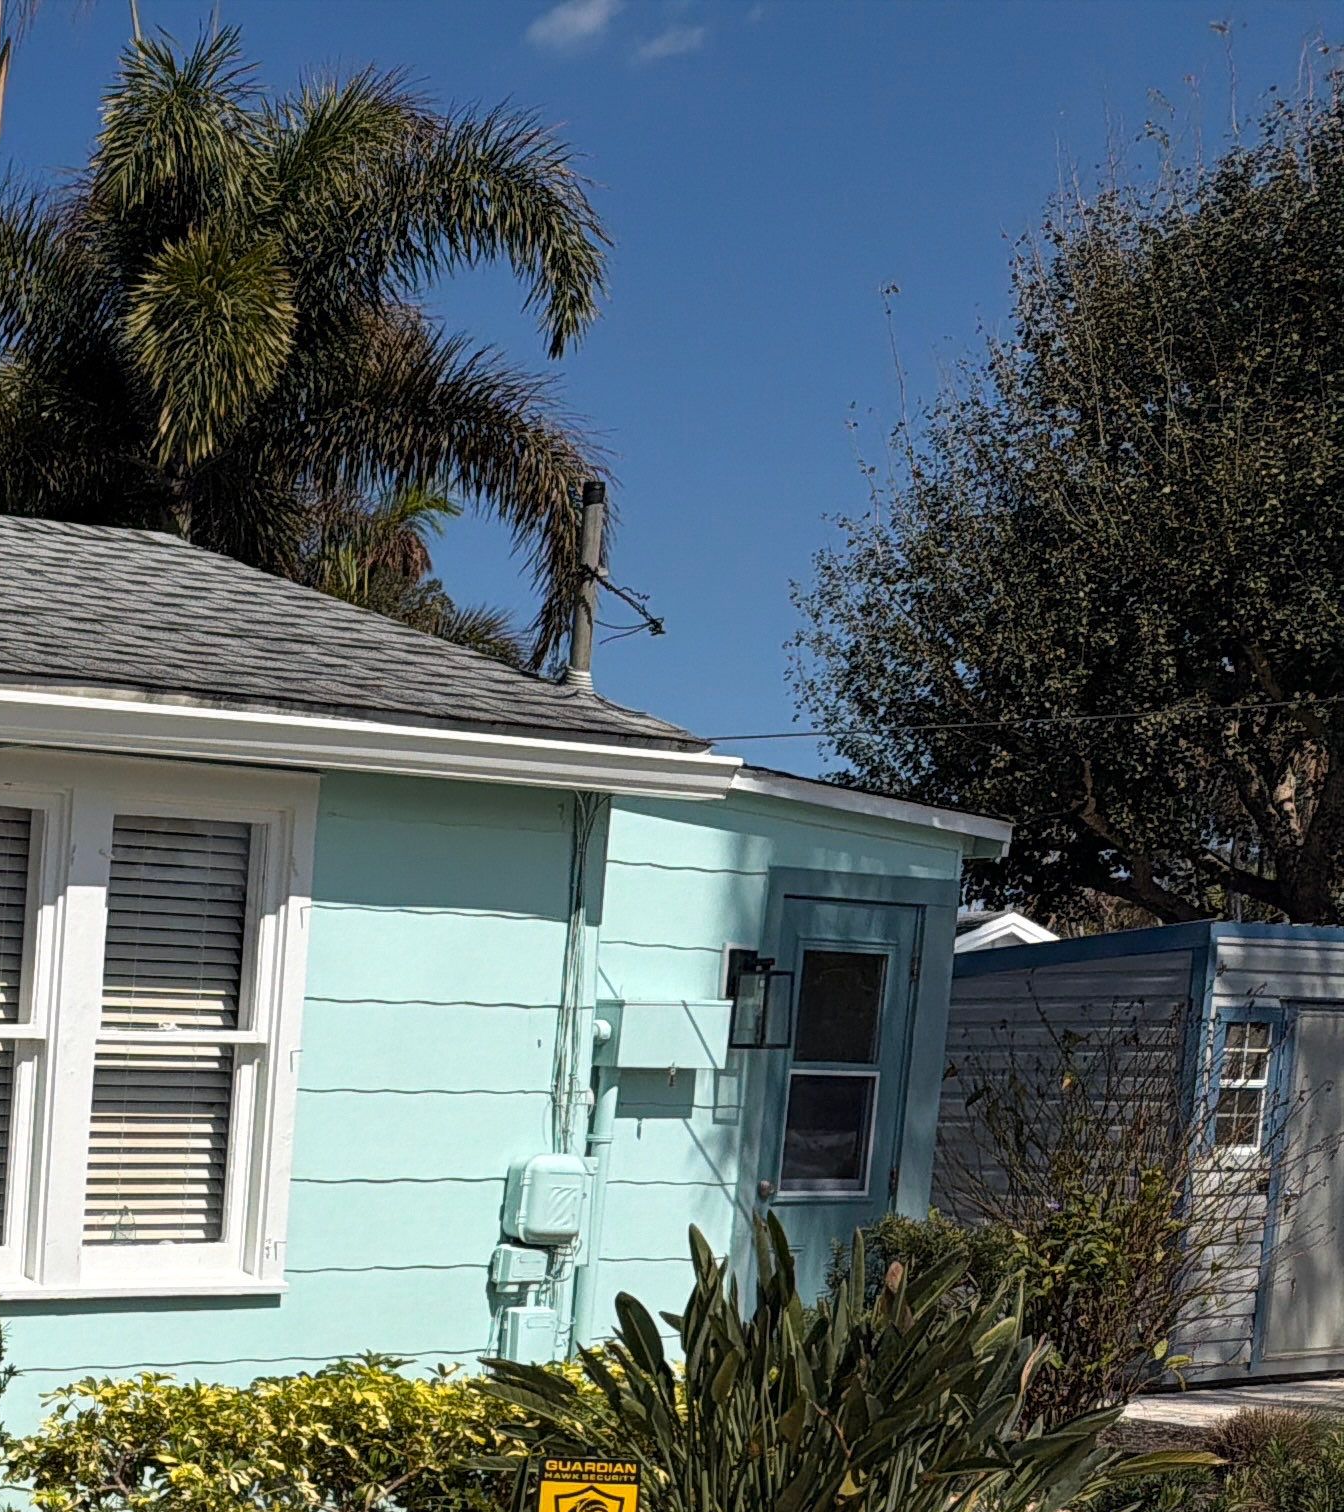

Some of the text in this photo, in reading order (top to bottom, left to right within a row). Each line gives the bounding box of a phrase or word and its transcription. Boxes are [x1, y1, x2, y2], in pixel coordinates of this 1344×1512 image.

[544, 1459, 638, 1474] GUARDIAN
[543, 1472, 637, 1482] HAWK SECURITY
